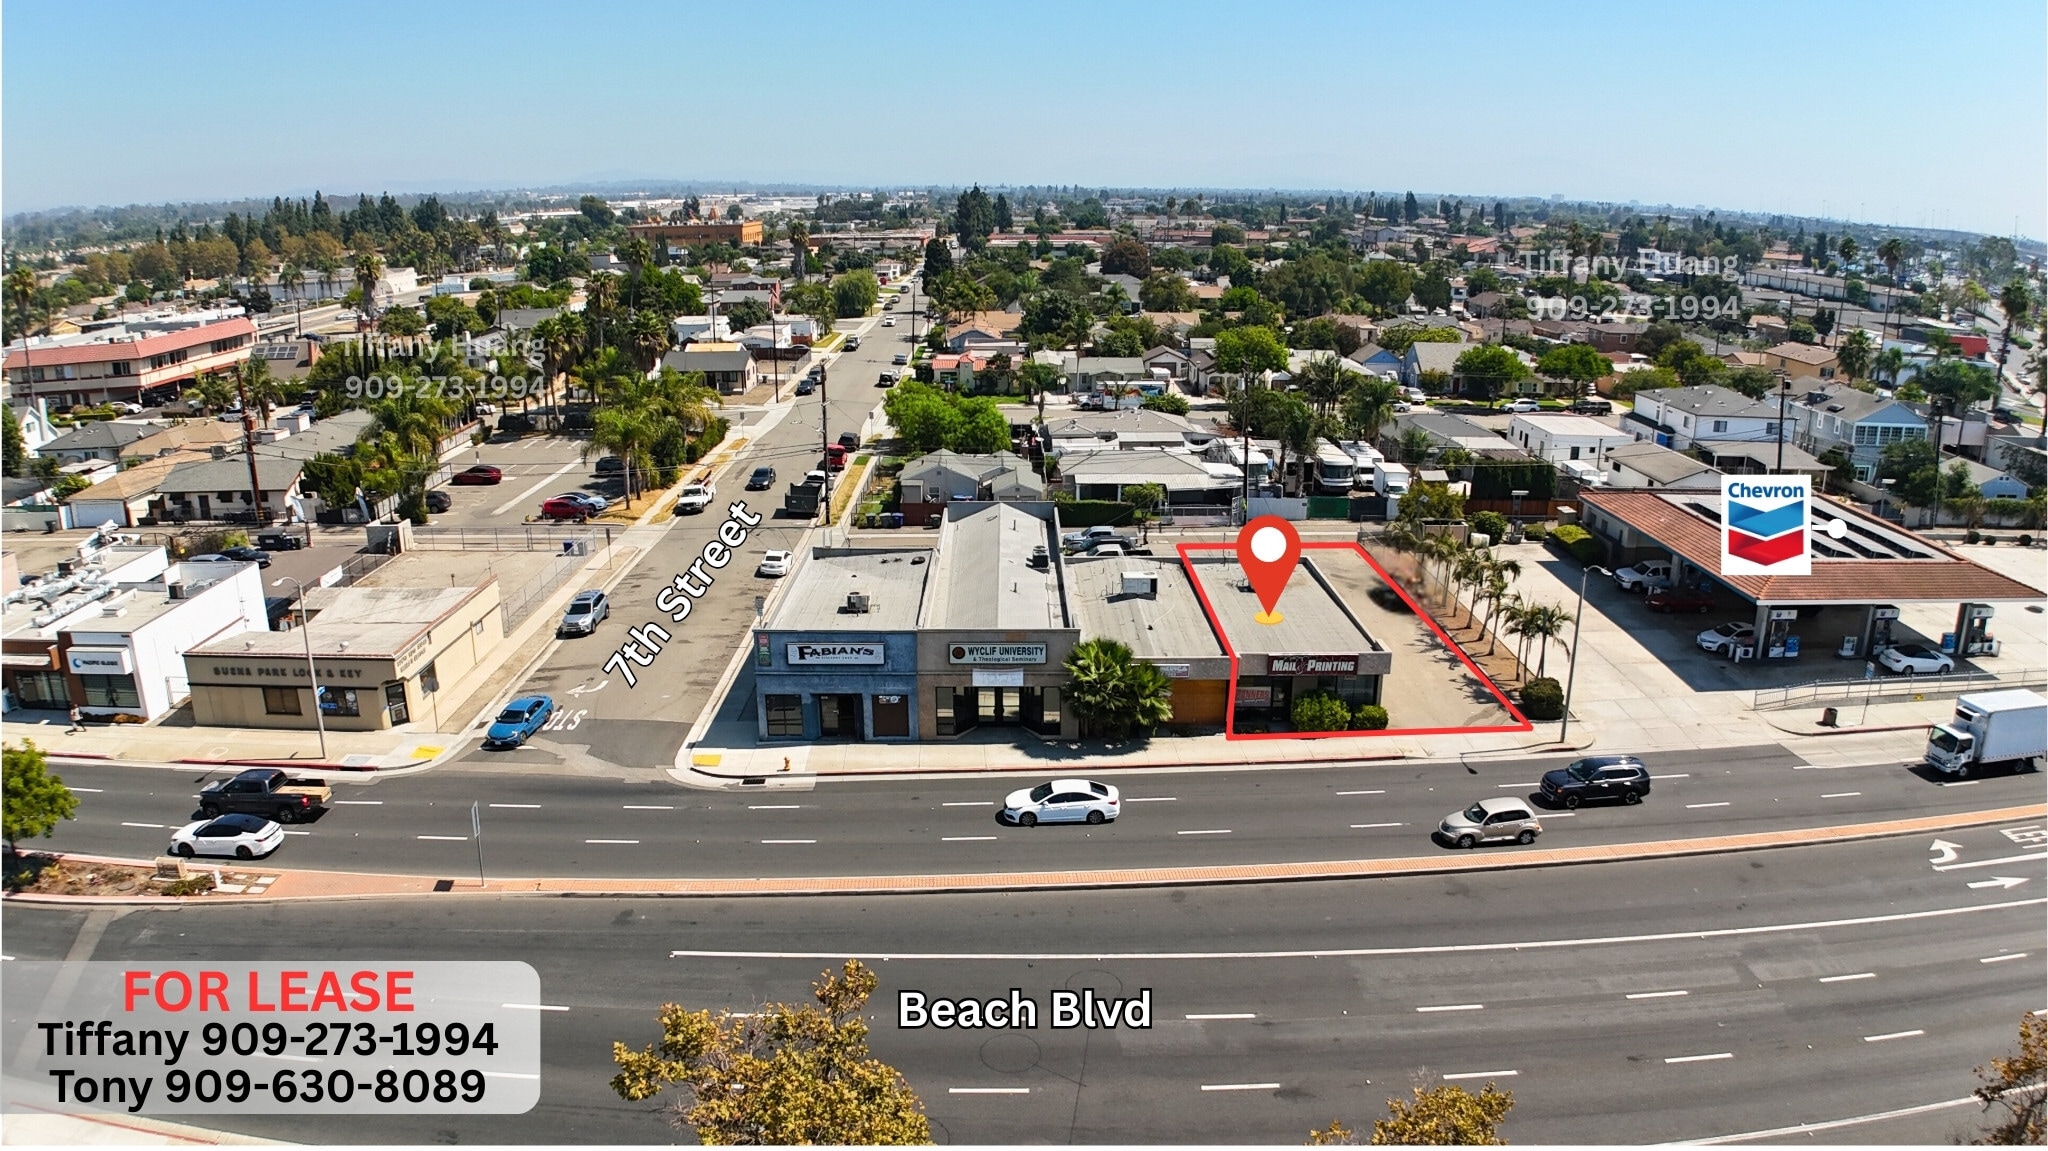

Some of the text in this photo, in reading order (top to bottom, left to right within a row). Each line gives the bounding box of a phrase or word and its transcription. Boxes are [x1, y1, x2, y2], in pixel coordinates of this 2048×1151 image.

[797, 646, 875, 660] FABIAN'S
[968, 647, 1044, 656] WYCLIF UNIVERSITY
[1272, 659, 1297, 671] MAIL
[1306, 659, 1355, 671] PRINTING
[213, 666, 252, 677] BUENA
[258, 667, 287, 677] PARK
[326, 669, 334, 678] &
[340, 669, 362, 678] KEY
[542, 709, 588, 731] STO
